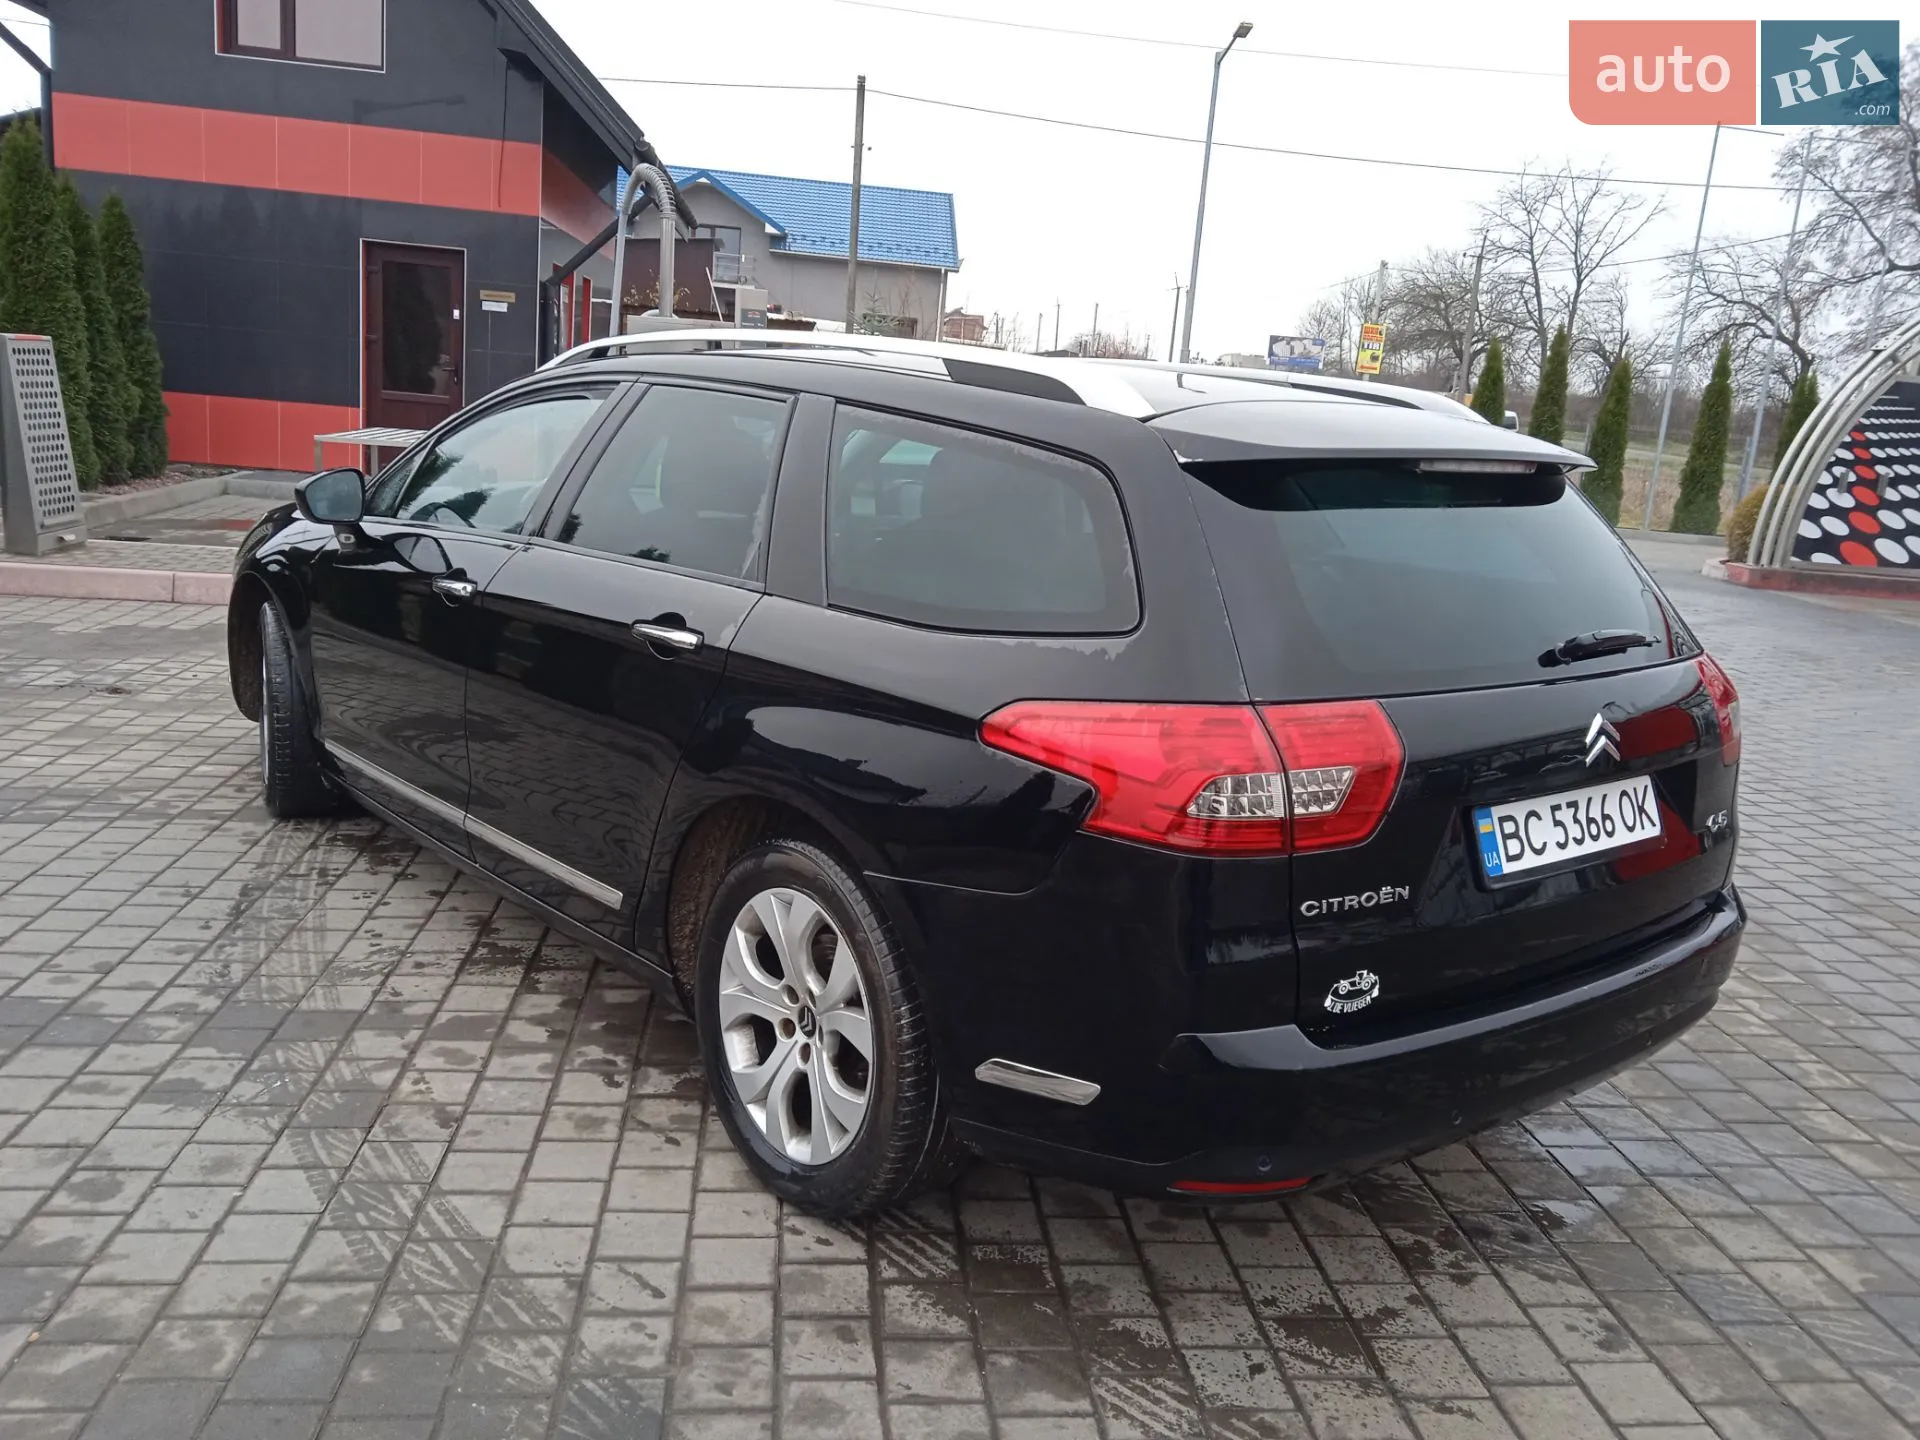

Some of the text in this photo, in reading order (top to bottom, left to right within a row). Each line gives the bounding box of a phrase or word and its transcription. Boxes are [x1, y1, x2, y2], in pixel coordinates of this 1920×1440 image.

[1497, 784, 1657, 863] BC 5366 OK
[1484, 851, 1501, 868] UA
